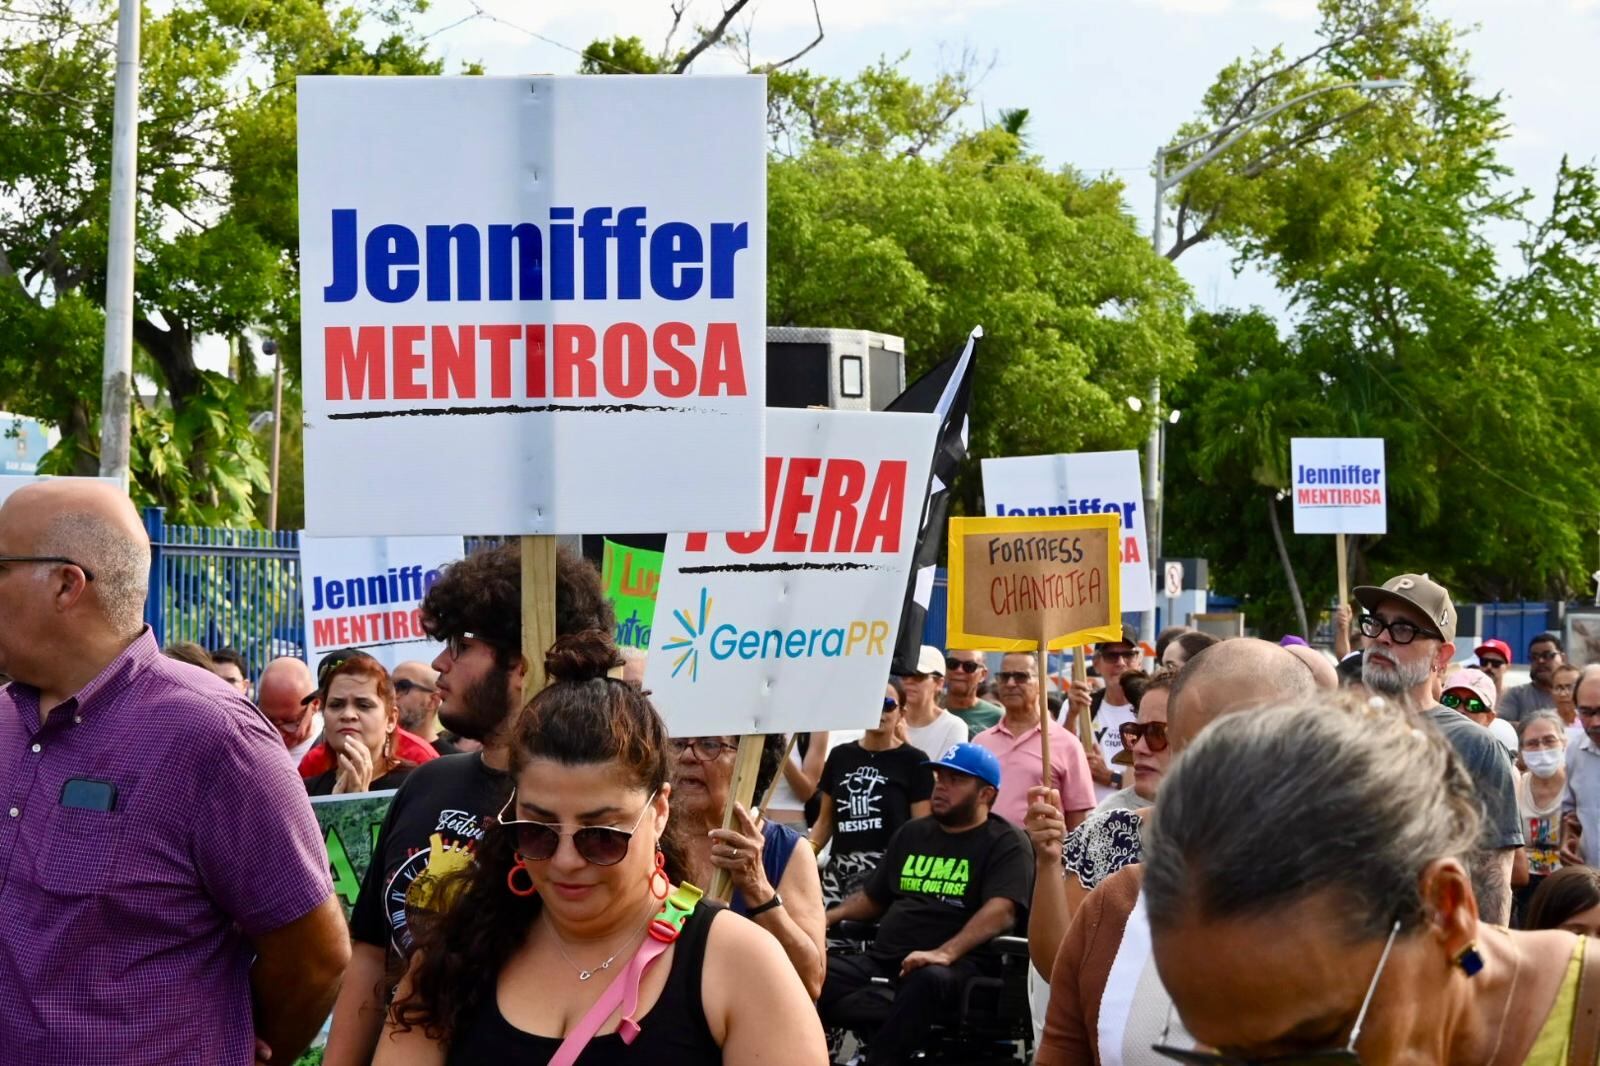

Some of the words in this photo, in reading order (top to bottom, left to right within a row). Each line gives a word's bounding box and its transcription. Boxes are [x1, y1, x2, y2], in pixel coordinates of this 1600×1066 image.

[323, 206, 748, 303] Jenniffer
[324, 321, 747, 400] MENTIROSA
[1298, 464, 1381, 484] Jenniffer
[684, 456, 908, 555] UERA
[1298, 489, 1381, 504] MENTIROSA
[988, 537, 1084, 566] FORTRESS
[990, 567, 1101, 617] CHANTAJEA
[709, 619, 889, 661] GeneraPR
[838, 817, 883, 833] RESISTE
[901, 854, 970, 882] LUMA
[900, 877, 923, 891] TIENE
[922, 880, 943, 893] QUE
[942, 881, 967, 896] IRSE
